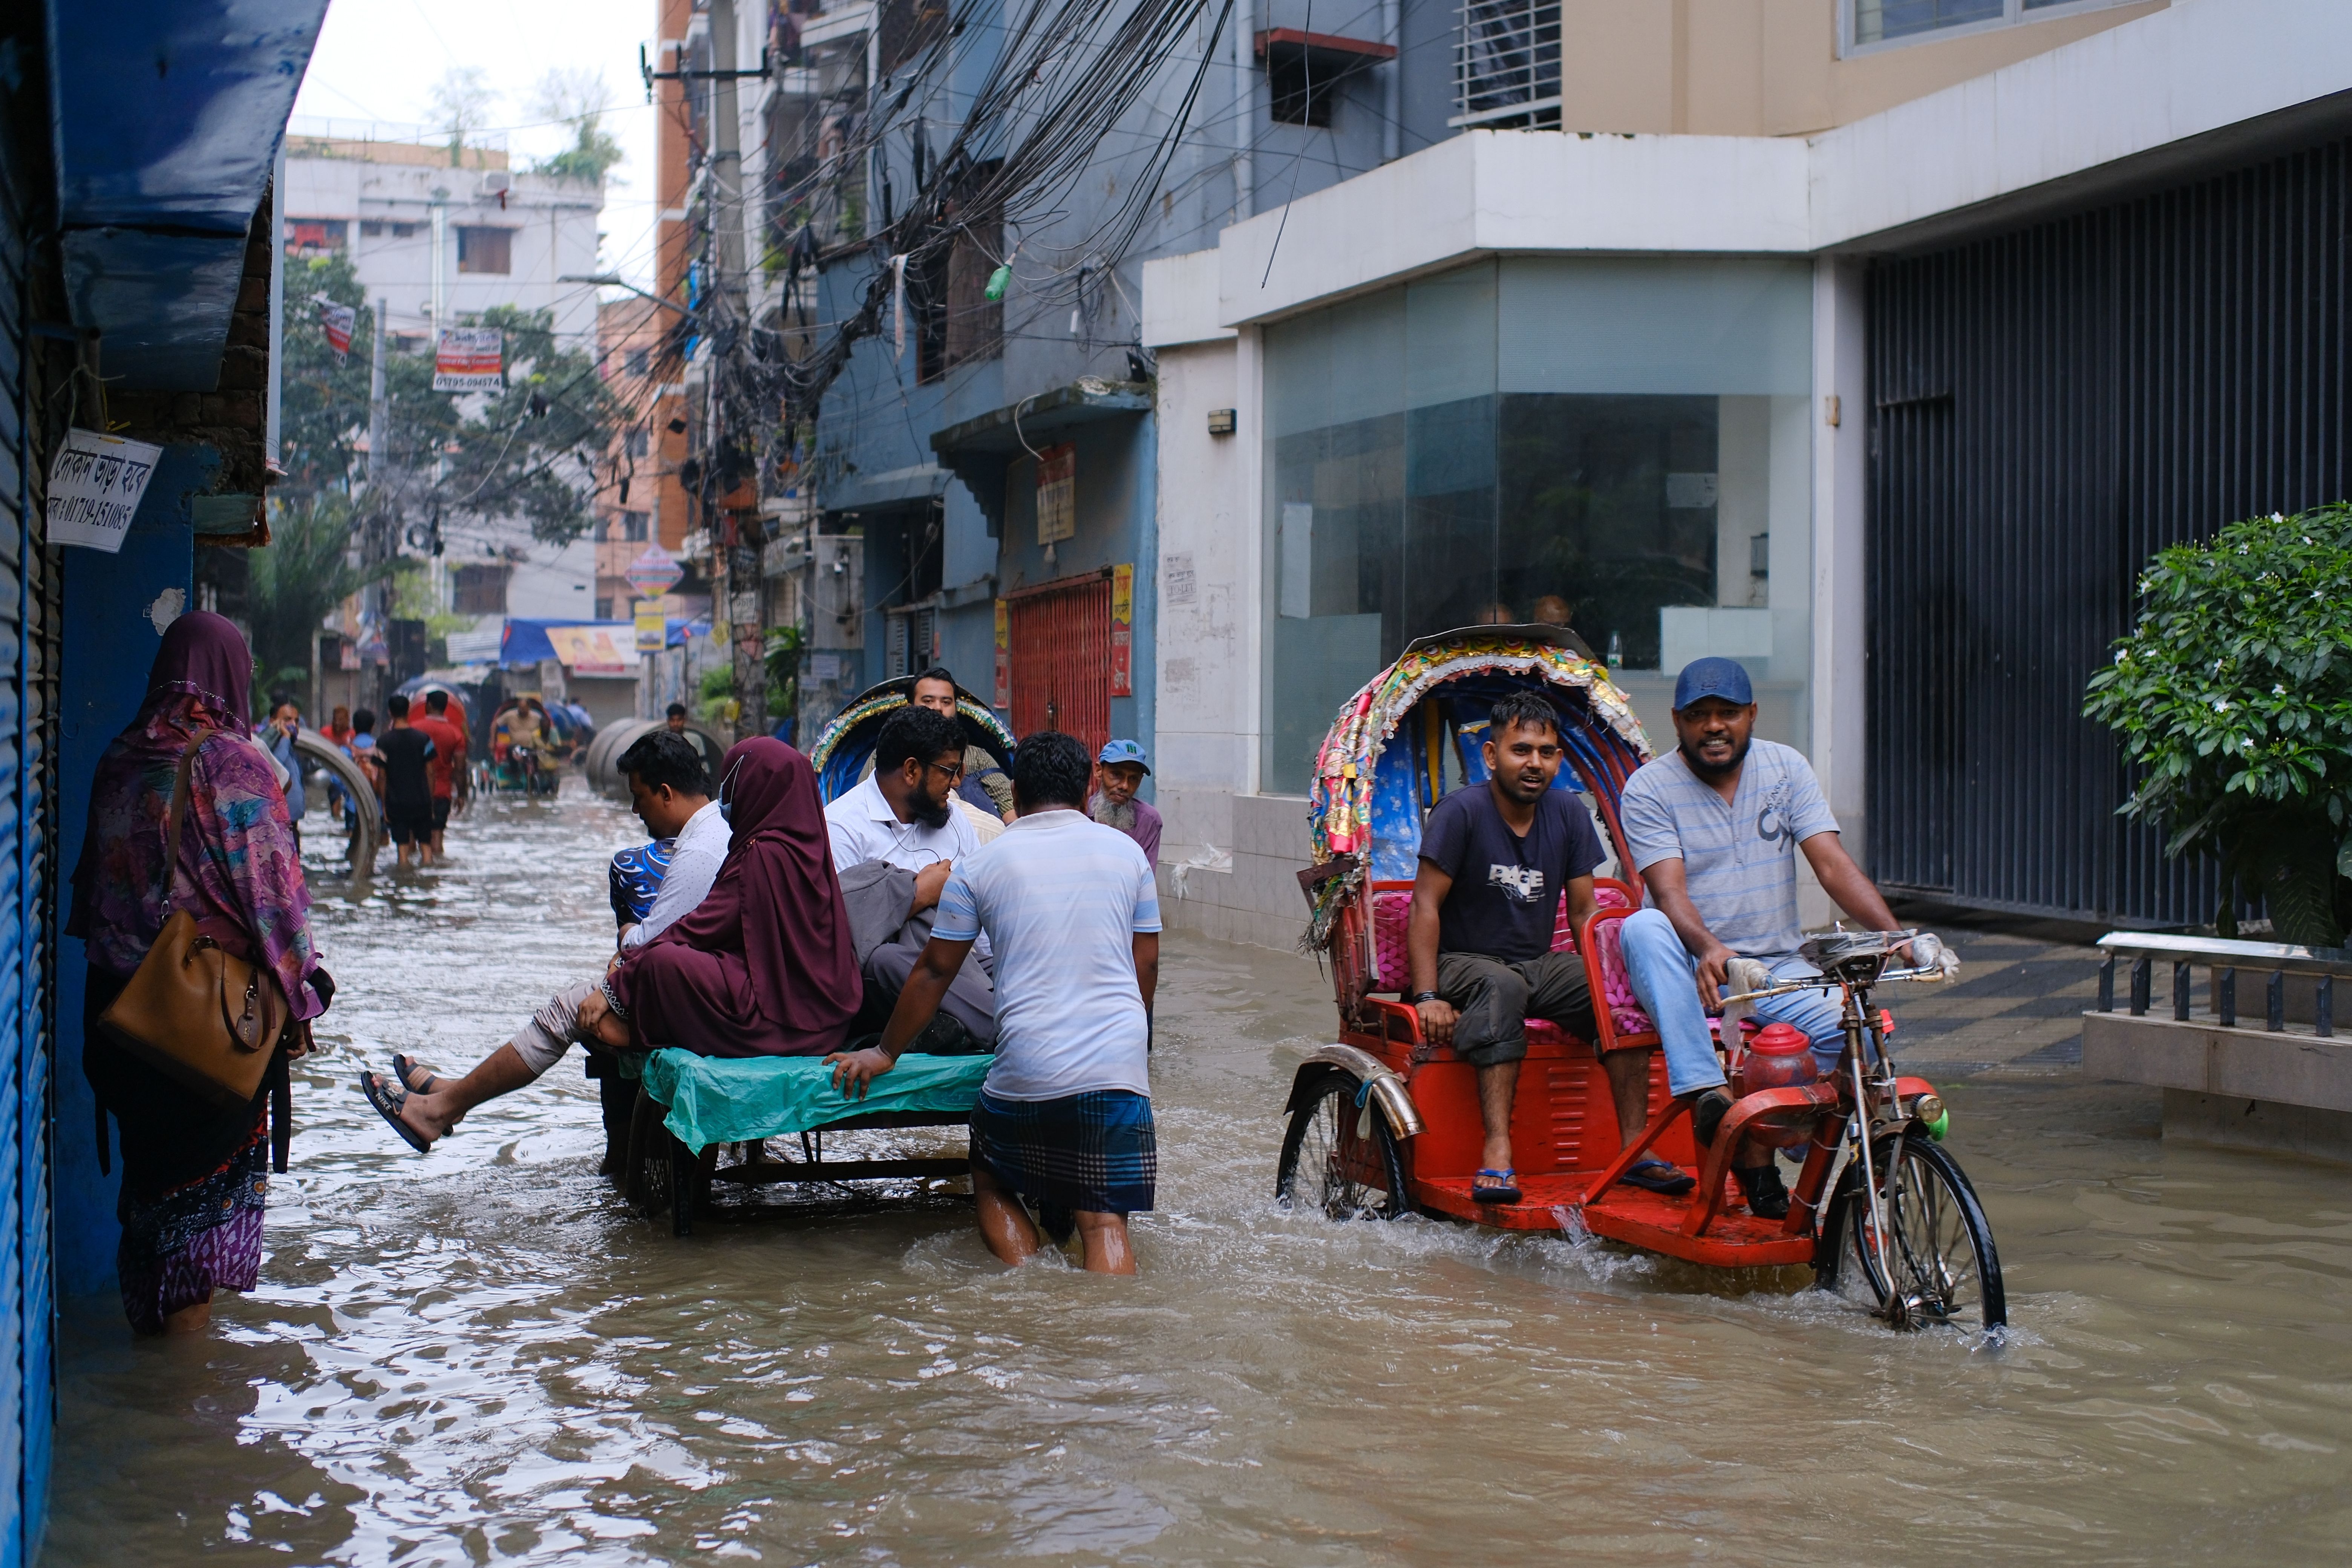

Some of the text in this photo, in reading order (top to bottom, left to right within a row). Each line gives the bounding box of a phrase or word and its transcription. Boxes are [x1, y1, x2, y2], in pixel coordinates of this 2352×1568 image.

[55, 446, 151, 497] দোকান ভাড়া হবে
[64, 496, 131, 530] 01719-151085
